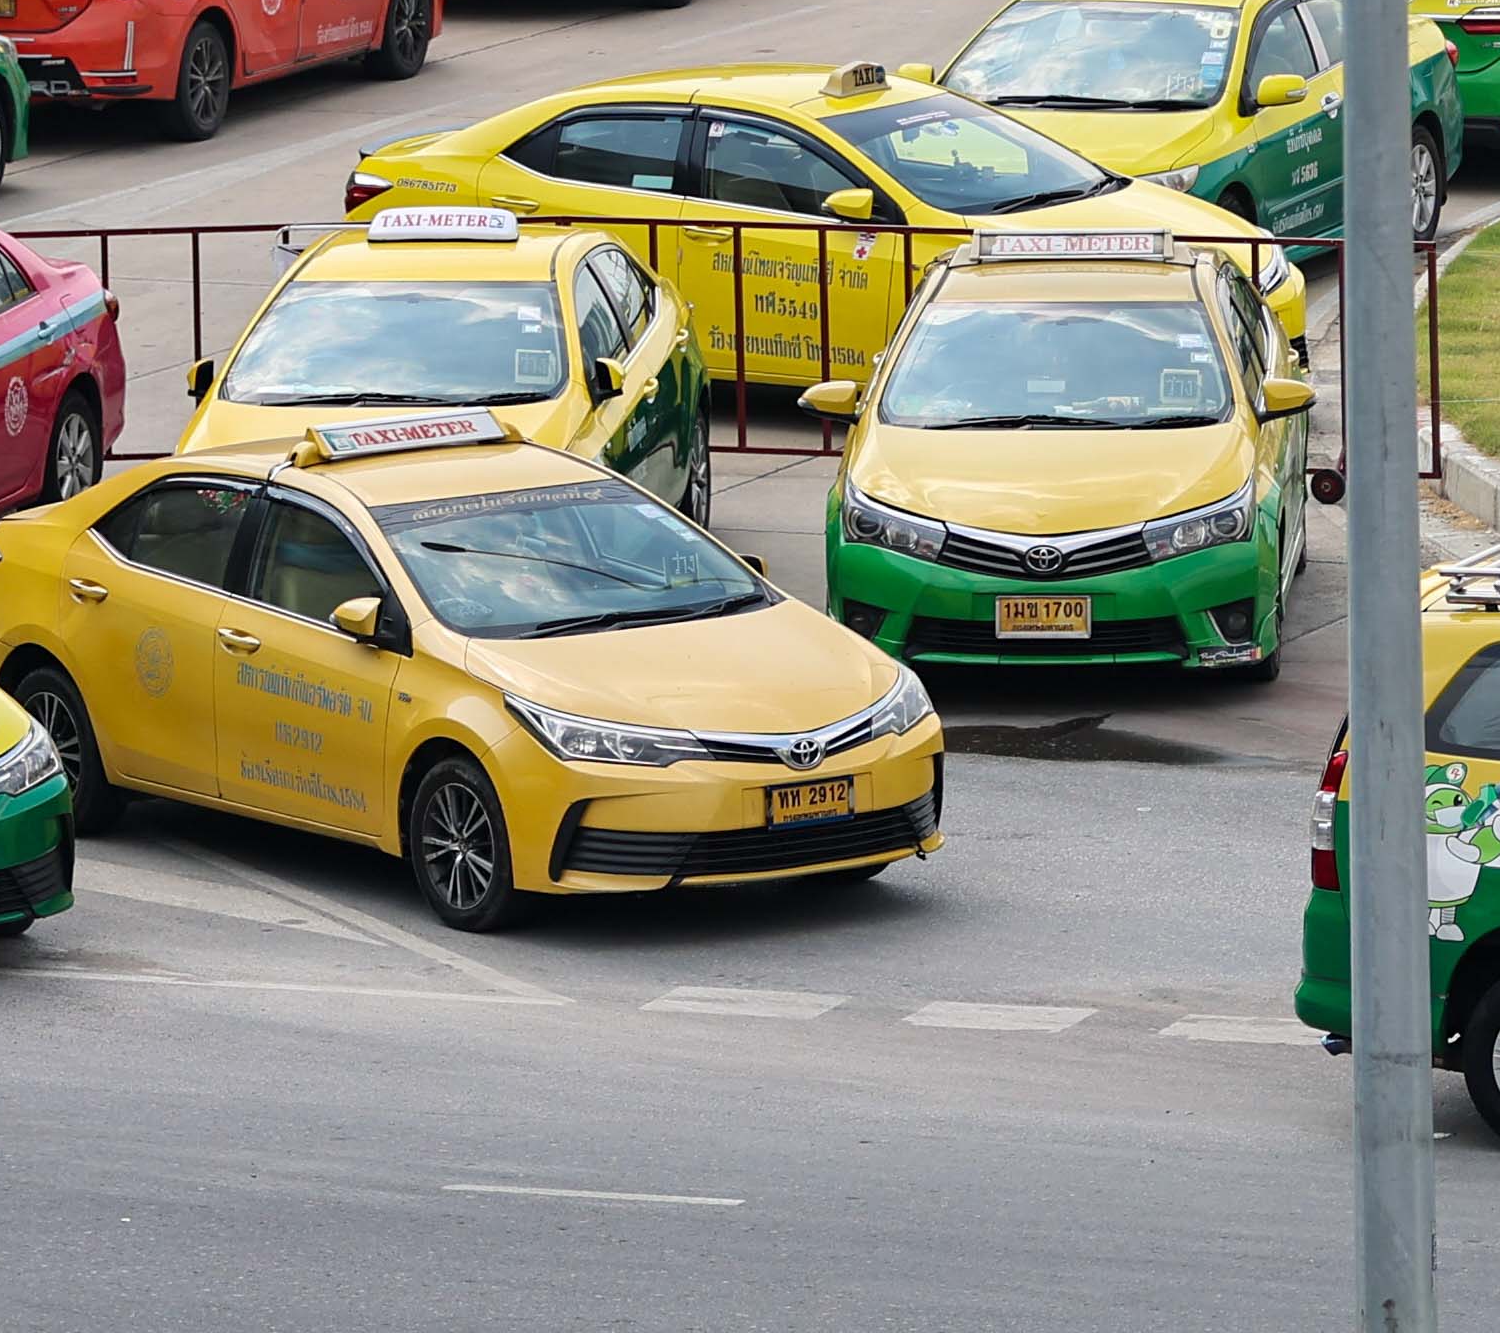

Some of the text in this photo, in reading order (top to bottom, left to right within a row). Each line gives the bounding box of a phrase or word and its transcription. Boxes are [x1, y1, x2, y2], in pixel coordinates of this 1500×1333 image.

[852, 69, 875, 87] TAXI
[380, 214, 488, 229] TAXI-METER
[996, 234, 1152, 254] TAXI-METER
[349, 419, 478, 450] TAXI-METER
[1004, 600, 1085, 618] 1มข 1700
[809, 782, 847, 806] 2912
